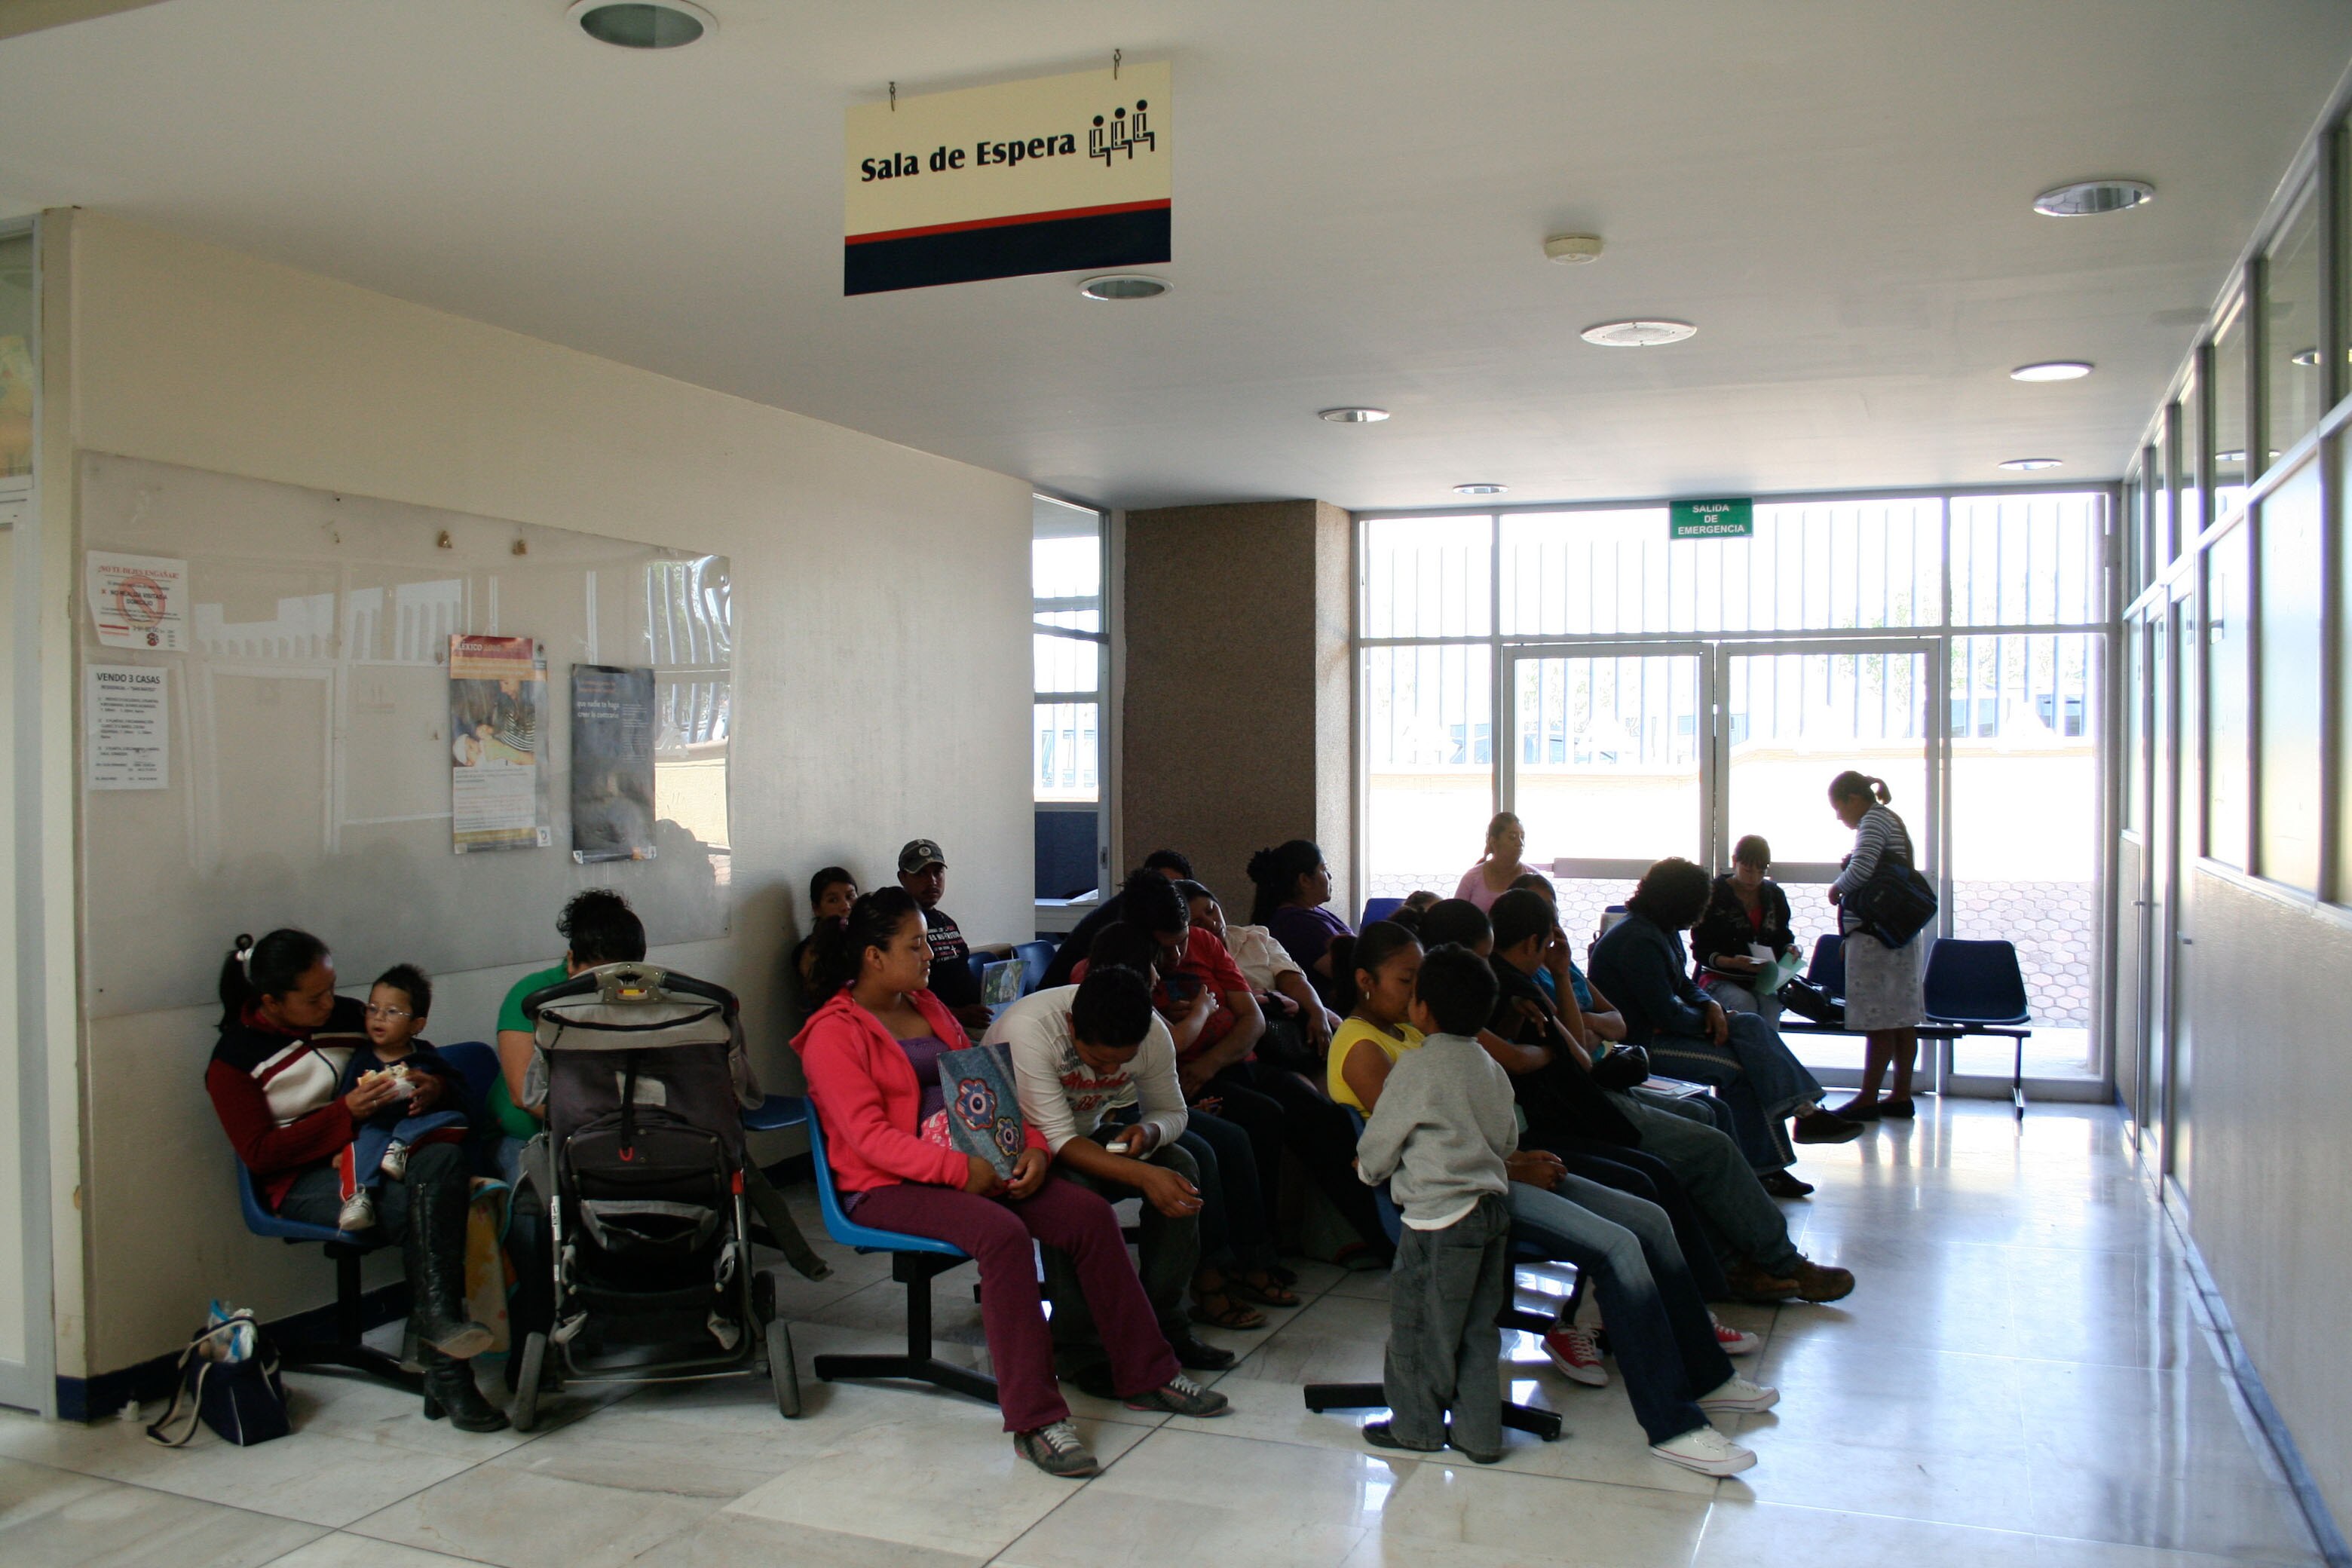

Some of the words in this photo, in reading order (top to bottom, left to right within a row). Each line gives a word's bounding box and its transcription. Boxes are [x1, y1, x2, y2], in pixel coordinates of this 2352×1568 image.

[862, 152, 920, 182] Sala
[929, 146, 966, 173] de
[977, 133, 1076, 167] Espera
[1692, 504, 1729, 513] SALIDA
[1704, 515, 1718, 523] DE
[1678, 525, 1744, 534] EMERGENCIA
[96, 672, 127, 682] VENDO
[128, 674, 133, 683] 3
[136, 675, 161, 684] CASAS
